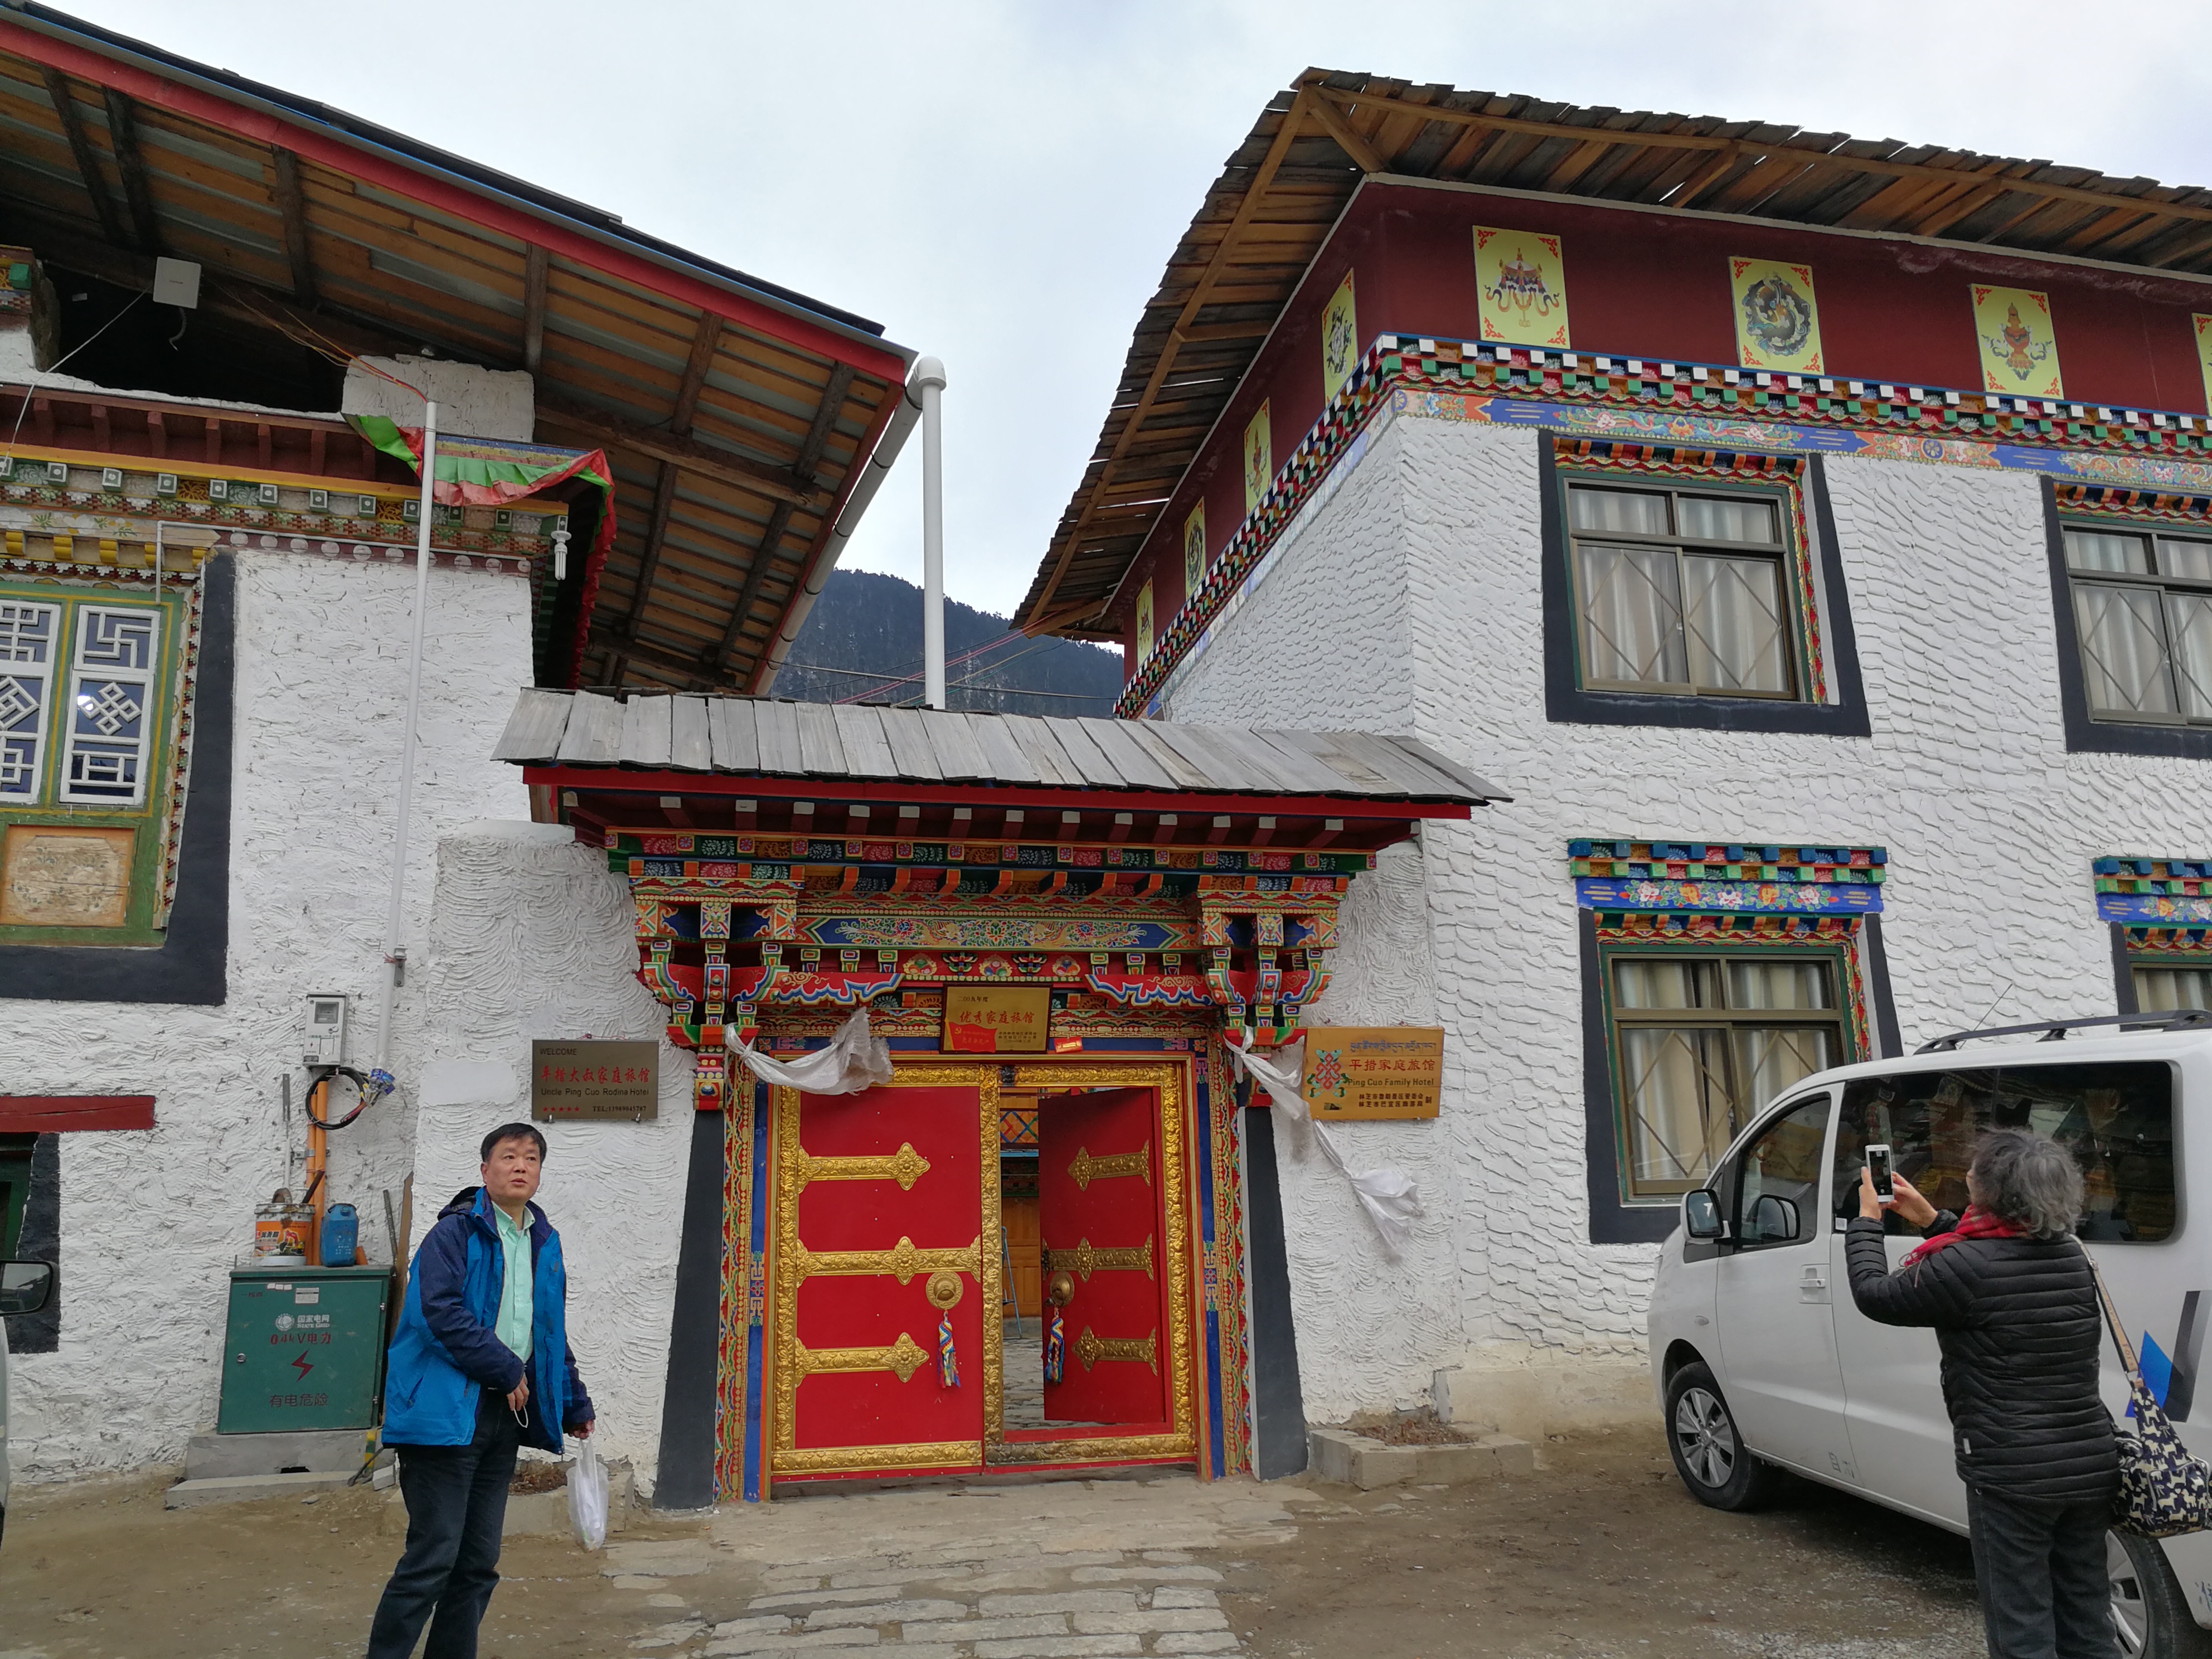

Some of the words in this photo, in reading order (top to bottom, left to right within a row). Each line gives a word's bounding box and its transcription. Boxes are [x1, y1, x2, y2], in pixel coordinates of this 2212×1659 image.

[959, 1010, 1035, 1024] 优秀家庭旅馆
[1349, 1059, 1435, 1071] 平措家庭旅馆
[540, 1065, 650, 1084] 平措大叔家庭旅馆
[1348, 1079, 1366, 1088] Ping
[1385, 1079, 1410, 1088] Family
[565, 1088, 581, 1098] Ping
[298, 1314, 330, 1323] 国家电网
[269, 1393, 328, 1408] 有电危险
